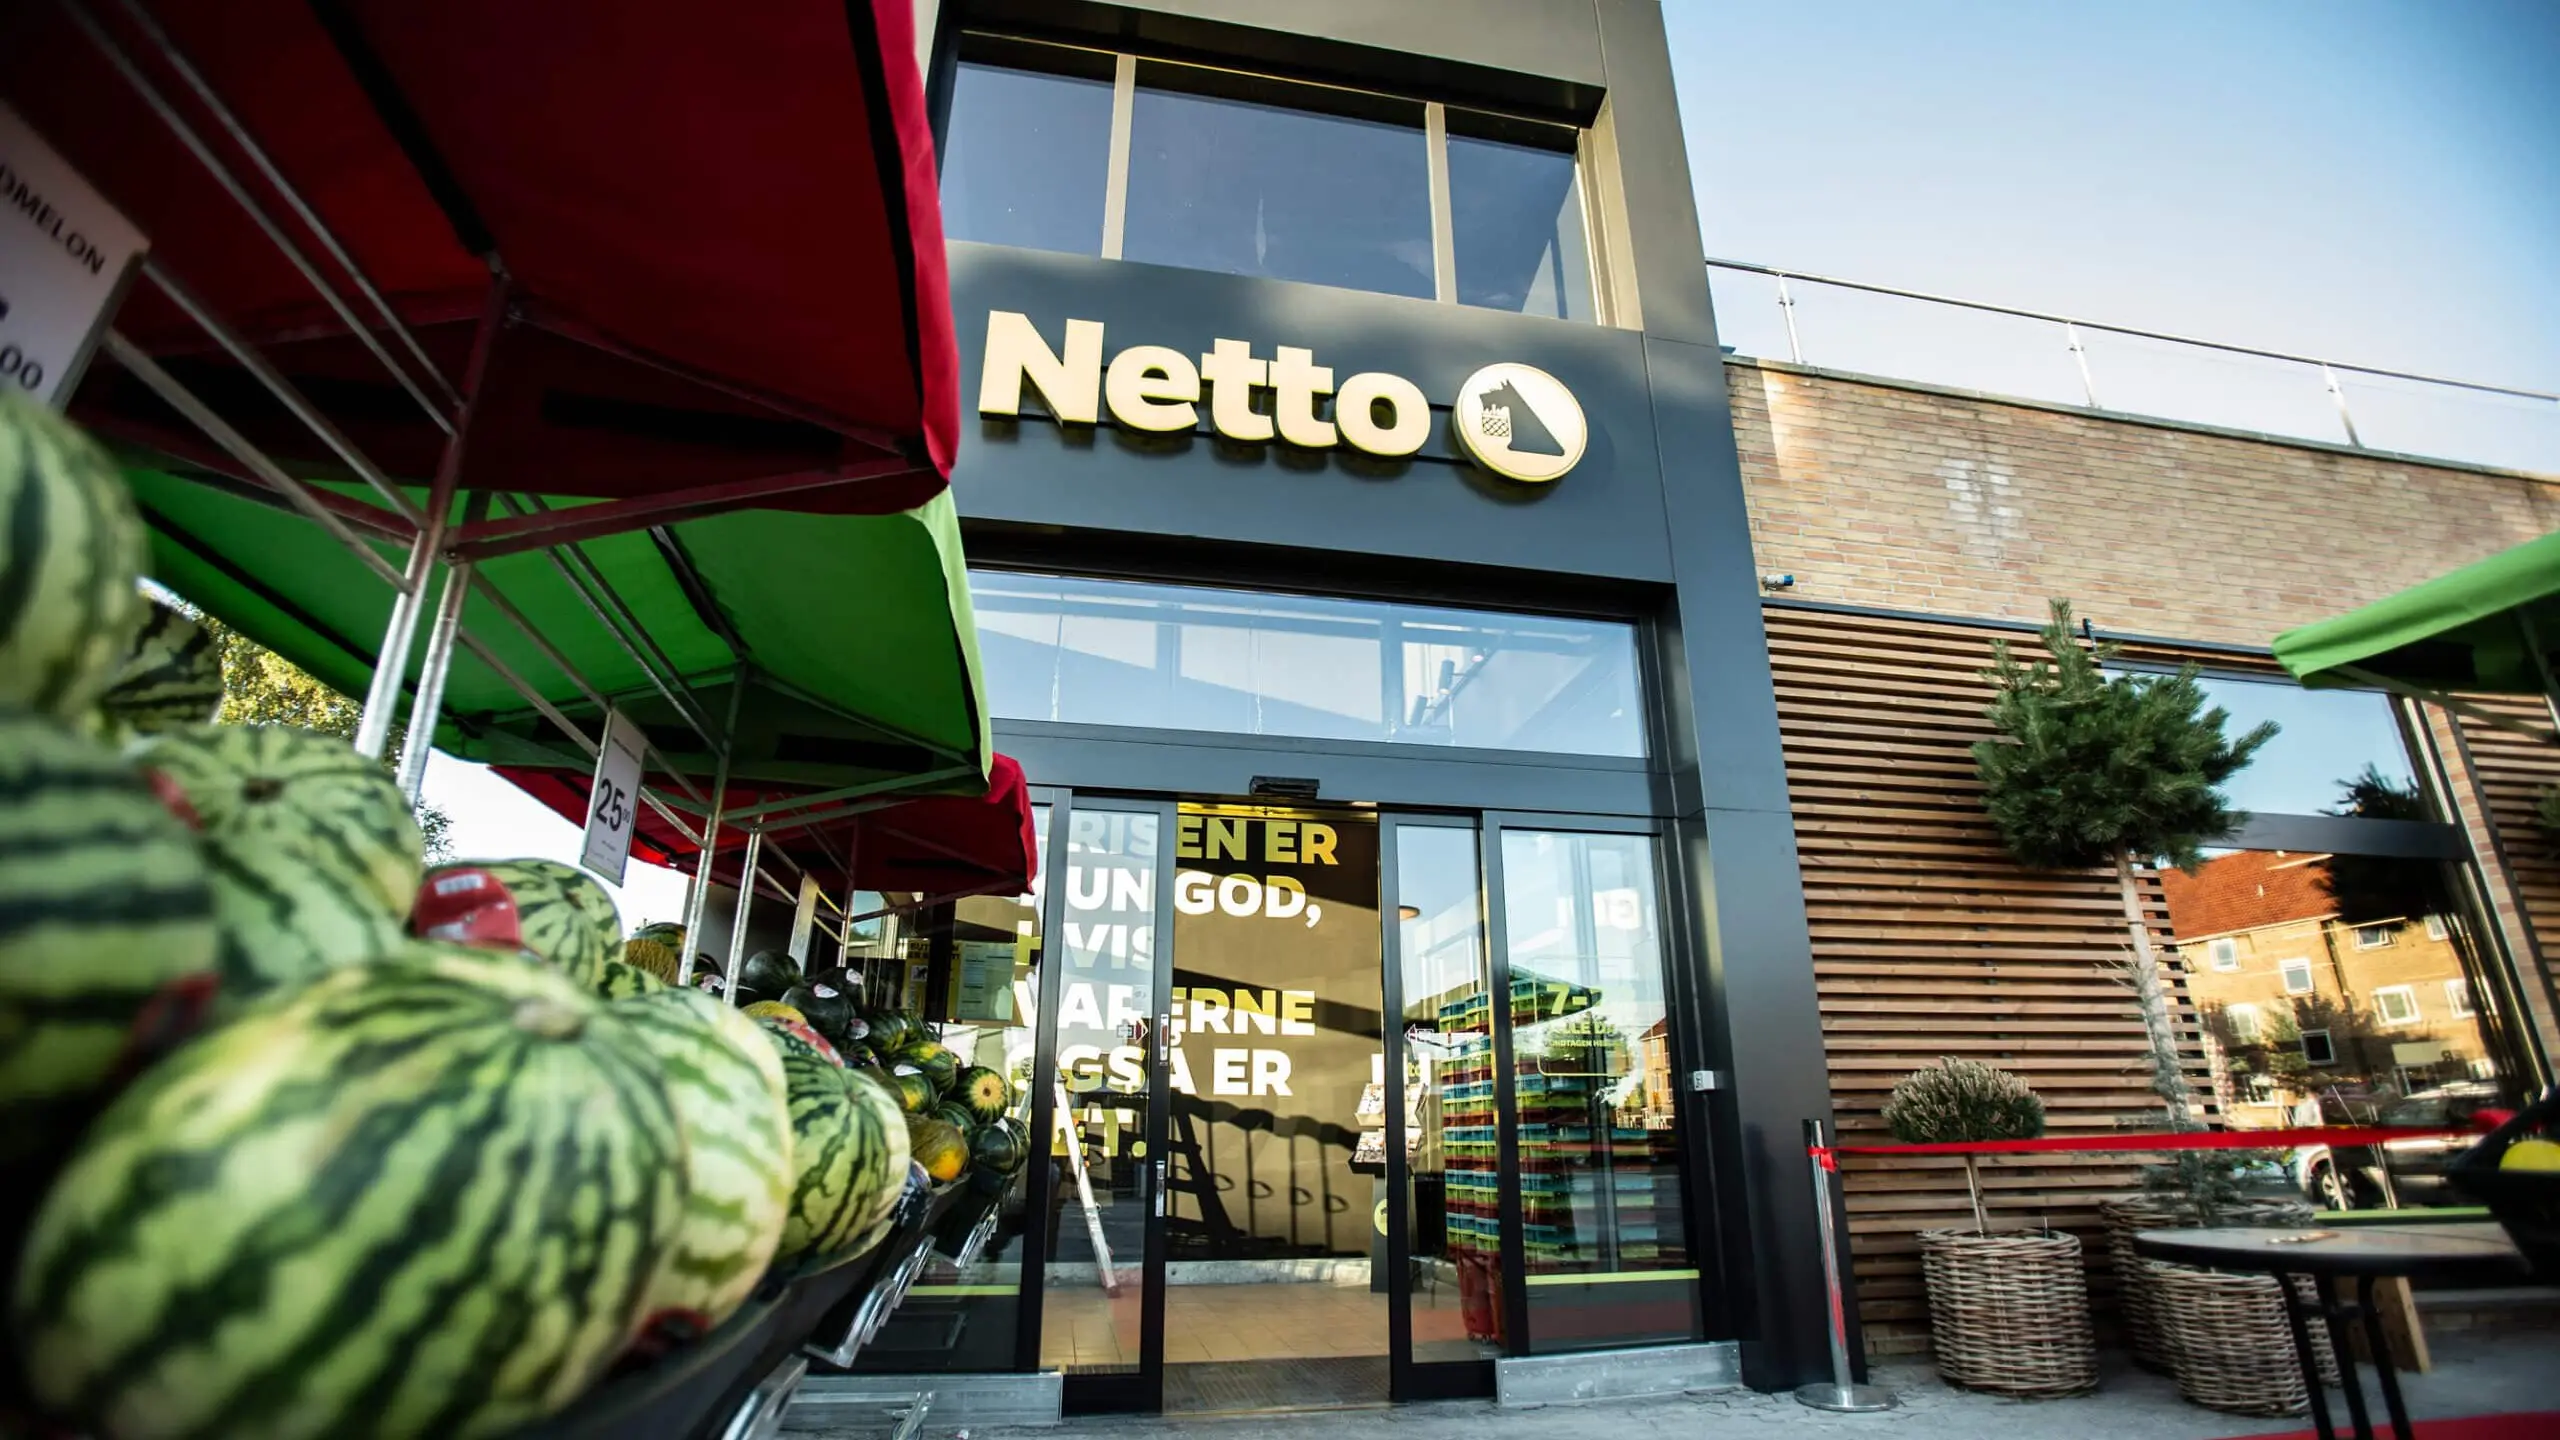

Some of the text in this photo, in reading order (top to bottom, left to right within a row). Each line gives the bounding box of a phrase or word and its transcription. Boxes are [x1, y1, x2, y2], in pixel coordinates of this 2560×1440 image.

[978, 310, 1431, 456] Netto
[1068, 813, 1339, 865] RISEN ER
[1020, 866, 1322, 928] UN GOD,
[1213, 1048, 1293, 1096] ER
